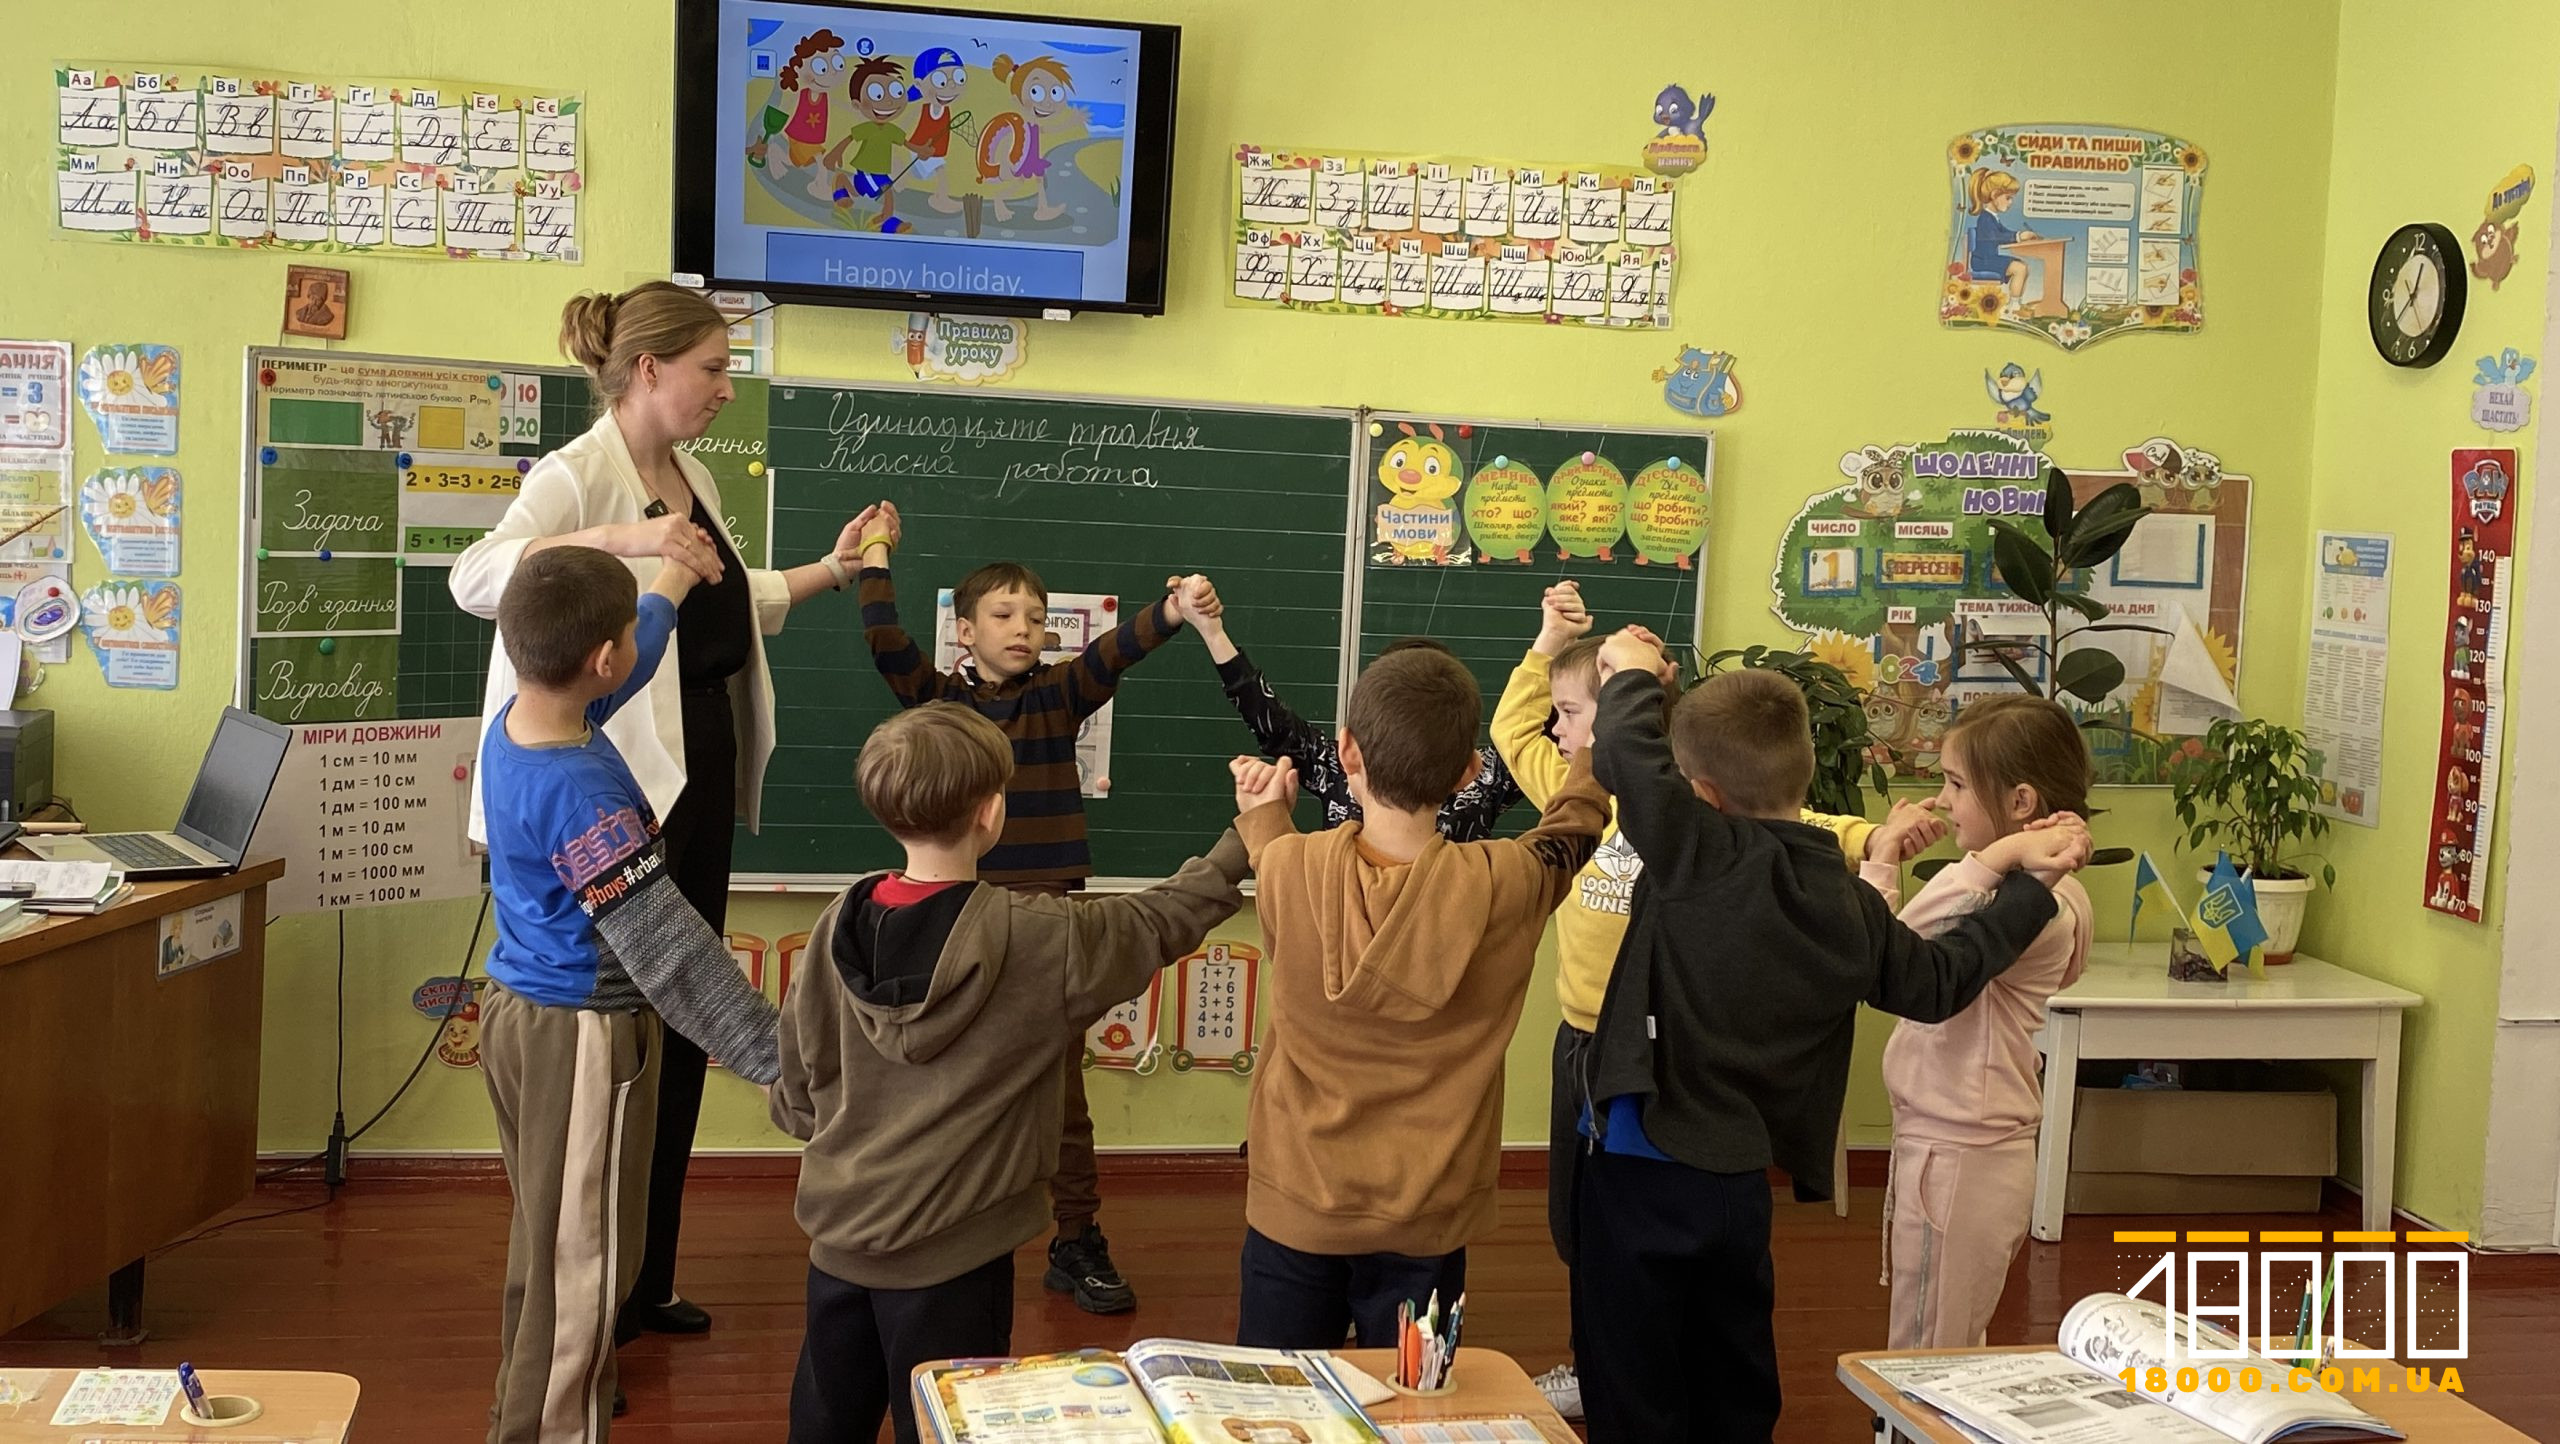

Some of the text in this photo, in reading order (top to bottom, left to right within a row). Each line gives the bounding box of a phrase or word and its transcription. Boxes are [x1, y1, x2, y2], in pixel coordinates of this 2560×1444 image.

[71, 74, 91, 86] Аа
[137, 76, 158, 89] Бб
[216, 82, 236, 94] Вв
[292, 88, 311, 99] Гг
[414, 93, 435, 107] Дд
[477, 97, 496, 109] Ее
[536, 102, 556, 114] Єє
[2018, 136, 2142, 152] СИДИ ТА ПИШИ
[71, 159, 95, 170] Мм
[157, 161, 179, 174] Нн
[1249, 156, 1271, 167] Жж
[2030, 155, 2128, 171] ПРАВИЛЬНО
[285, 170, 306, 182] Пп
[1379, 165, 1396, 176] Ии
[345, 174, 366, 188] Рр
[400, 176, 419, 188] Сс
[1523, 172, 1540, 185] Йй
[1580, 176, 1596, 188] Кк
[1635, 179, 1652, 191] Лл
[457, 179, 476, 192] Тт
[539, 184, 558, 198] Уу
[1248, 232, 1270, 246] Фф
[1303, 235, 1321, 246] Хх
[2414, 233, 2426, 251] 12
[1402, 243, 1418, 254] Чч
[1445, 244, 1467, 256] Шш
[1562, 252, 1584, 263] Юю
[1623, 253, 1640, 265] Яя
[824, 259, 1025, 296] Happy holiday.
[940, 321, 1010, 341] Правила
[948, 346, 998, 364] уроку
[2408, 342, 2416, 358] 6
[262, 360, 458, 383] ПЕРИМЕТР це сума довжин усіх
[313, 375, 448, 390] будь-якого многокутника
[28, 382, 43, 403] 3
[518, 384, 538, 403] 10
[515, 416, 539, 438] 20
[1069, 409, 1203, 461] травня
[820, 436, 1158, 498] Класна робота
[406, 471, 417, 487] 2
[1571, 476, 1607, 489] Ознака
[1661, 480, 1679, 490] Дія
[2463, 468, 2509, 500] PAW
[1491, 481, 1518, 494] Назва
[1480, 493, 1526, 505] предмета
[1566, 489, 1613, 500] предмета
[1649, 492, 1697, 503] предмета
[1551, 500, 1587, 511] який?
[1633, 501, 1708, 515] що робити?
[2475, 501, 2498, 512] PATROL
[282, 489, 384, 551] Задача
[1381, 510, 1449, 525] Частини
[1472, 507, 1539, 520] хто? що?
[1559, 513, 1616, 524] яке? які?
[1630, 513, 1711, 528] що зробити?
[1393, 526, 1437, 539] мови
[1812, 524, 1856, 533] ЧИСЛО
[1898, 526, 1948, 536] МІСЯЦЬ
[411, 534, 421, 548] 5
[2478, 549, 2495, 562] 140
[1823, 552, 1839, 580] 1
[1896, 562, 1962, 575] ВЕРЕСЕНЬ
[1960, 603, 1993, 612] ТЕМА
[2128, 604, 2155, 615] ДНЯ
[2475, 600, 2491, 613] 130
[1892, 610, 1912, 620] РІК
[2469, 650, 2485, 663] 120
[2472, 700, 2486, 713] 110
[303, 724, 441, 745] МІРИ ДОВЖИНИ
[320, 752, 417, 768] 1 см 10 мм
[2465, 749, 2482, 763] 100
[320, 775, 415, 793] 1 дм 10 см
[320, 797, 427, 816] 1 дм 100 мм
[2465, 800, 2478, 812] 90
[319, 821, 406, 838] 1 м 10 дм
[319, 843, 413, 861] 1 м 100 см
[331, 864, 425, 883] м 1000 мм
[330, 887, 421, 905] км 1000 м
[2454, 899, 2466, 912] 70
[1214, 948, 1223, 961] 8
[1228, 967, 1236, 978] 7
[1200, 982, 1235, 993] 2 6
[1199, 997, 1234, 1008] 3 5
[1198, 1011, 1233, 1022] 4 4
[1198, 1026, 1233, 1037] 8 0
